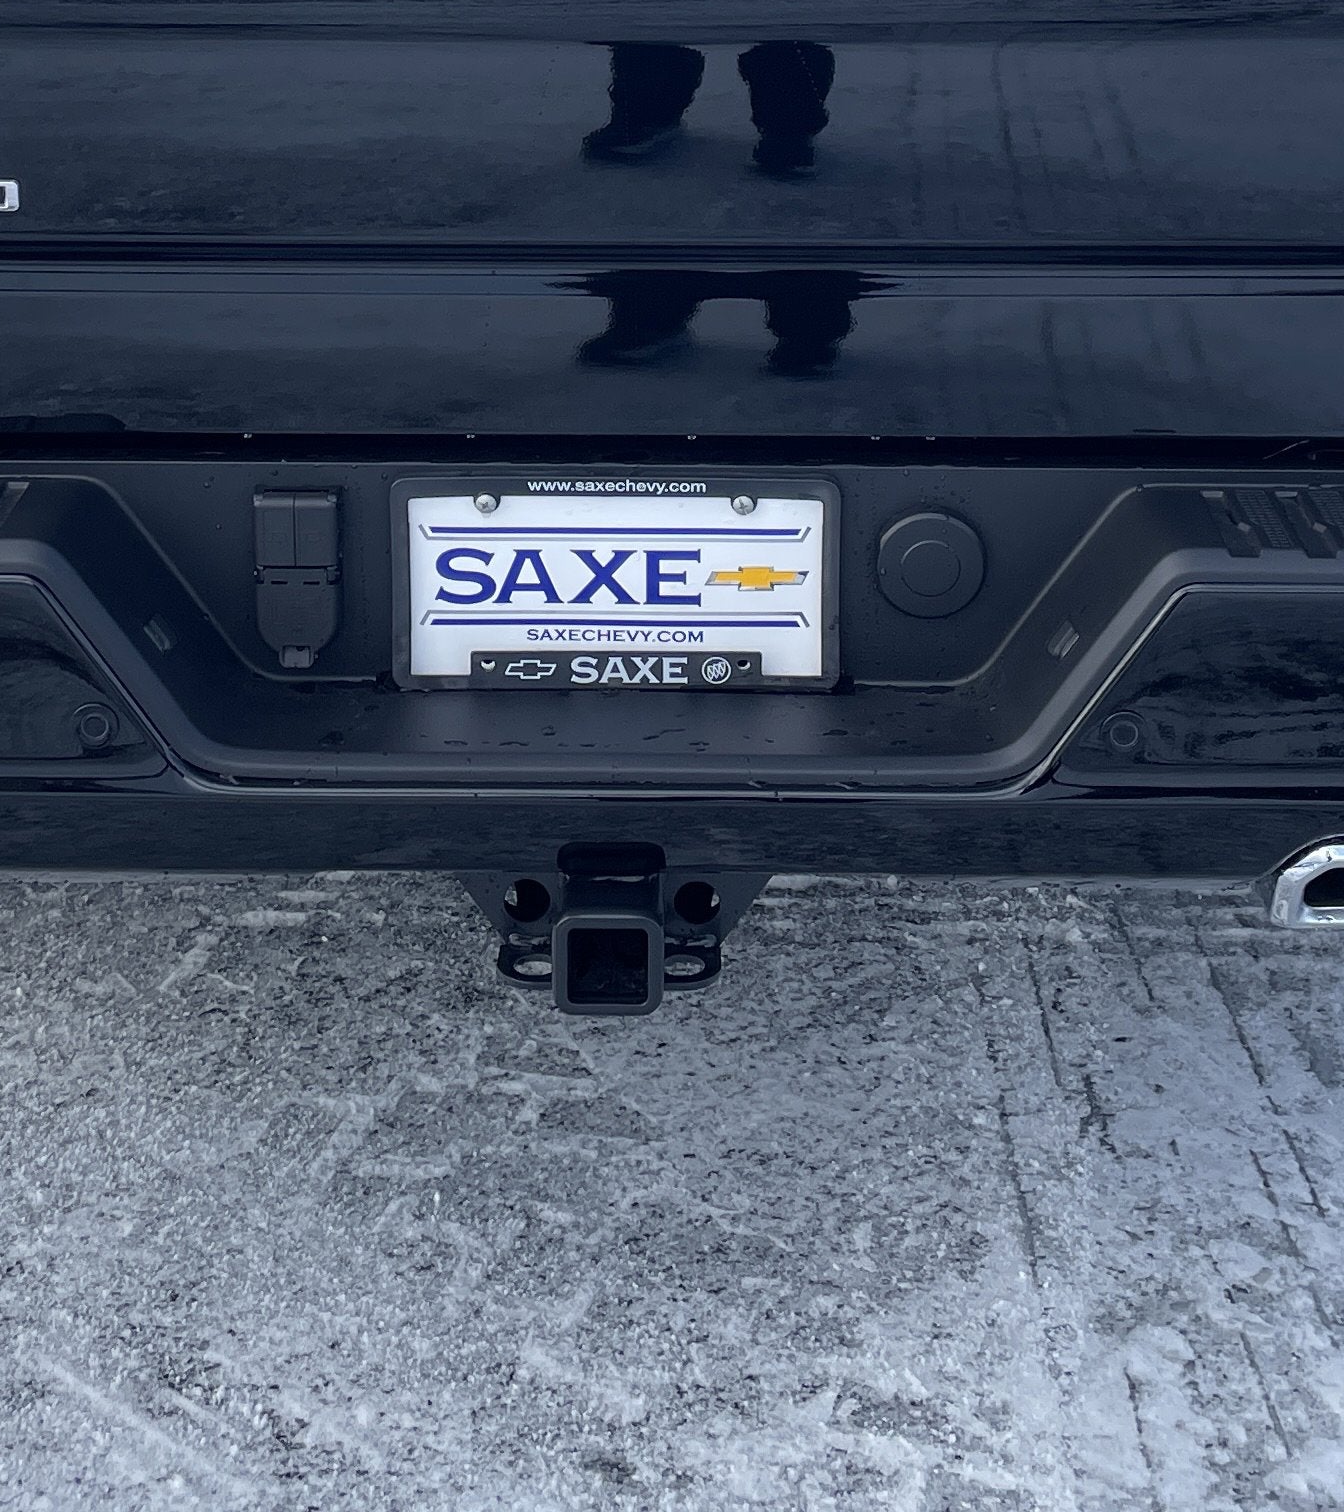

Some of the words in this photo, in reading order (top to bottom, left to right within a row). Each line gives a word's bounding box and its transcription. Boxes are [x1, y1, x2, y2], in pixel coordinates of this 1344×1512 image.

[527, 478, 707, 495] www.saxechevy.com
[434, 547, 702, 607] SAXE
[526, 628, 705, 644] SAXECHEVY.COM
[569, 655, 689, 685] SAXE
